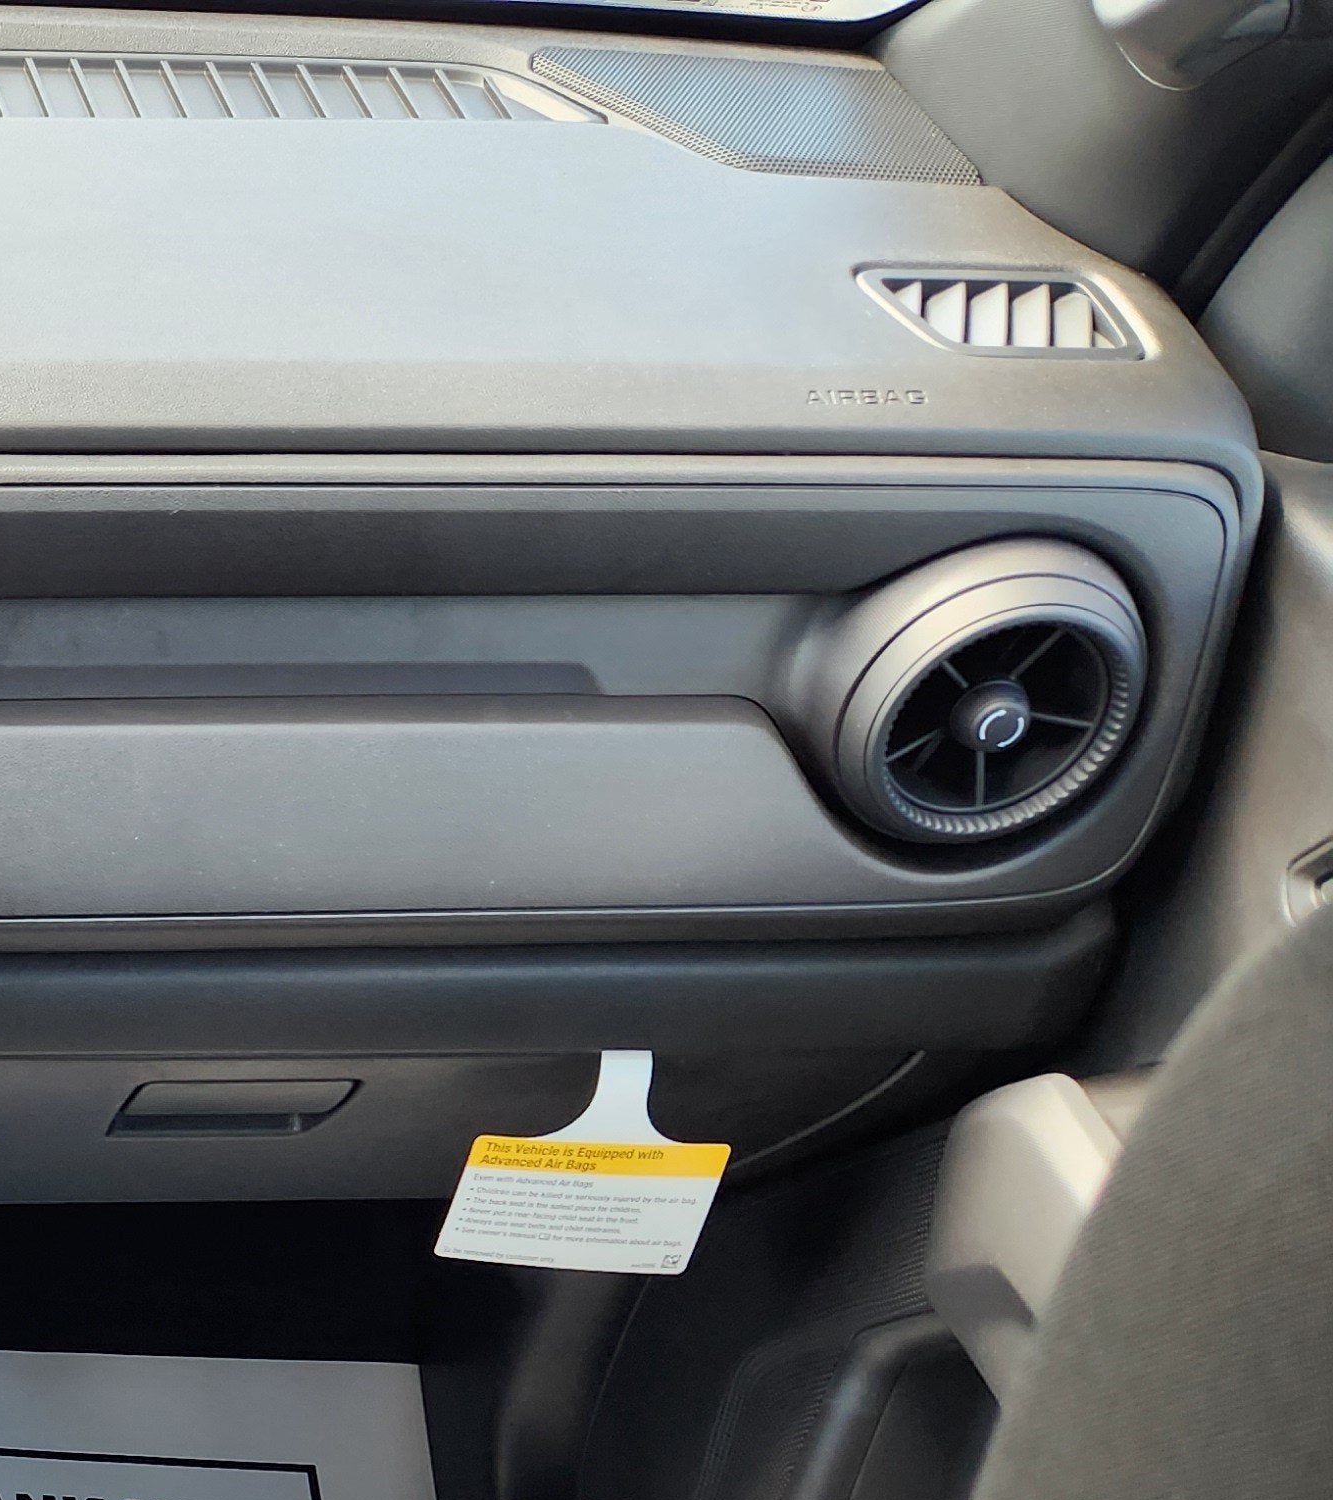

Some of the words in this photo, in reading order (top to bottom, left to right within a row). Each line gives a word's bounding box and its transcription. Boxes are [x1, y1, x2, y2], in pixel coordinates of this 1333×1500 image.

[807, 389, 929, 405] AIRBAG
[486, 1141, 512, 1154] This
[515, 1143, 560, 1157] Vehicle
[562, 1145, 574, 1157] is
[576, 1147, 635, 1161] Equipped
[638, 1149, 664, 1160] with
[480, 1153, 541, 1169] Advanced
[544, 1158, 563, 1169] Air
[565, 1159, 597, 1173] Bags
